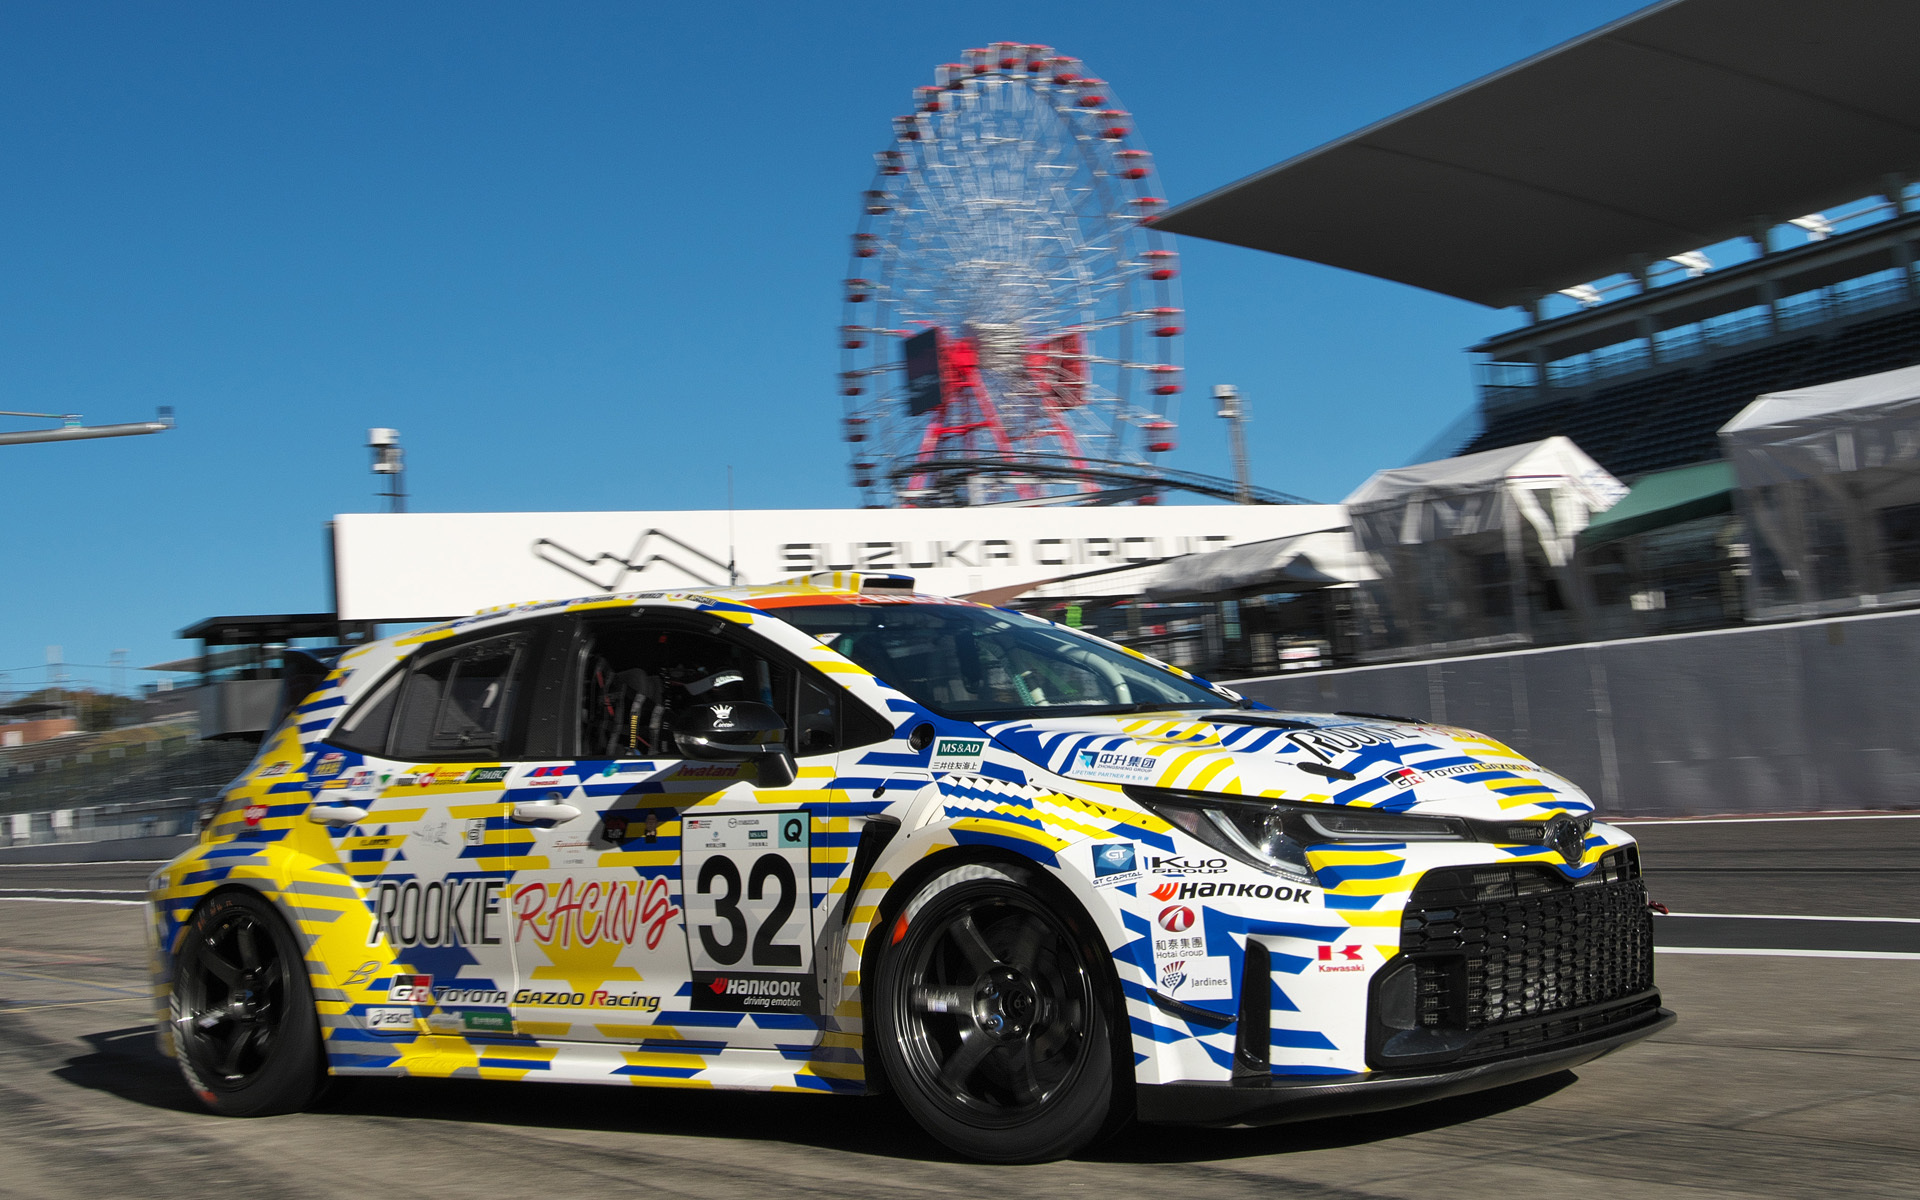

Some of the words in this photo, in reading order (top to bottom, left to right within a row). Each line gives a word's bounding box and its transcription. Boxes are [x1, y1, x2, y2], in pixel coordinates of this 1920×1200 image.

[779, 539, 1018, 571] SUZUKA
[940, 742, 980, 753] MS&AD
[1100, 753, 1157, 769] 中升集团
[677, 765, 742, 777] Iwatani
[1097, 771, 1125, 779] PARTNER
[1421, 763, 1479, 780] TOYOTA
[784, 818, 802, 843] Q
[1105, 849, 1127, 859] GT
[1105, 871, 1143, 883] CAPITAL
[370, 882, 503, 945] ROOKIE
[514, 877, 679, 951] RACING
[697, 853, 802, 967] 32
[1156, 936, 1203, 950] 和泰集團
[1156, 950, 1179, 959] Hotai
[1180, 949, 1204, 959] Group
[1318, 964, 1365, 973] Kawasaki
[1191, 978, 1228, 987] Jardines
[389, 984, 430, 1003] GR
[433, 986, 507, 1004] TOYOTA
[514, 989, 585, 1006] GAZOO
[590, 990, 661, 1012] Racing
[743, 996, 769, 1007] driving
[771, 997, 801, 1007] emotion
